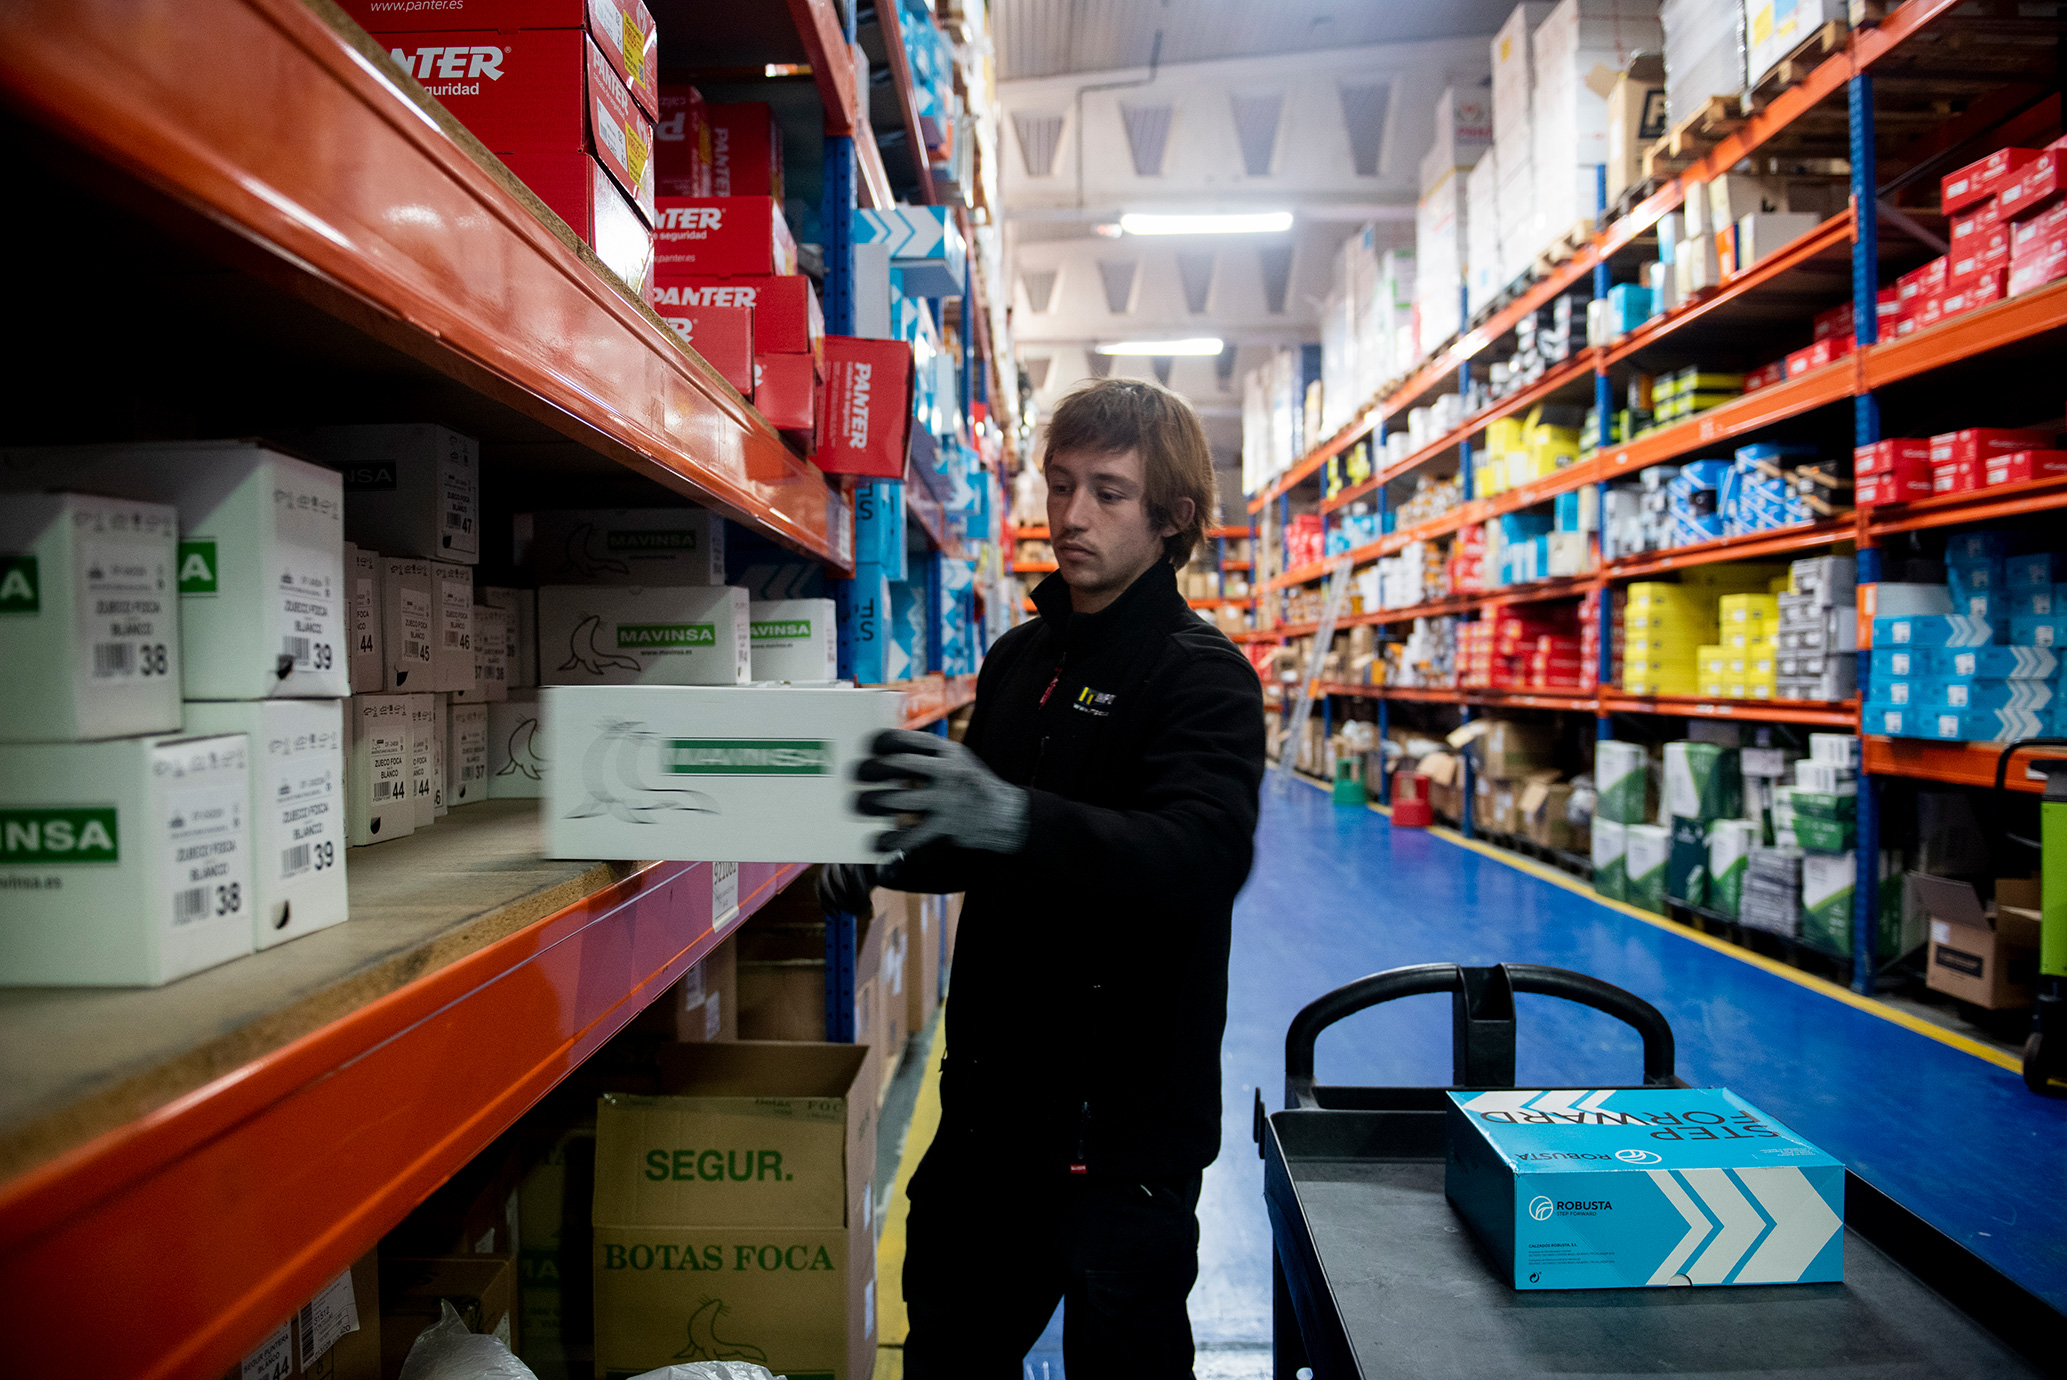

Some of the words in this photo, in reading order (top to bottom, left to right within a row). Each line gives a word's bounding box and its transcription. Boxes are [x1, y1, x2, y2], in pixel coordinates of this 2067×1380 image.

[371, 0, 464, 12] www.panter.es
[593, 50, 629, 116] PANTER
[659, 230, 707, 242] seguridad
[849, 362, 872, 449] PANTER
[462, 517, 473, 534] 47
[360, 634, 374, 653] 44
[459, 634, 470, 650] 46
[619, 628, 714, 643] MAVINSA
[141, 644, 169, 677] 38
[313, 642, 333, 670] 39
[419, 644, 430, 662] 45
[374, 759, 390, 768] ZUECO
[390, 757, 403, 766] FOCA
[475, 764, 485, 780] 37
[381, 769, 399, 779] BLANCO
[392, 781, 405, 800] 44
[418, 778, 430, 797] 44
[314, 840, 334, 871] 39
[215, 881, 242, 917] 38
[1480, 1109, 1761, 1125] FORWARD
[1650, 1125, 1780, 1142] STEP
[645, 1149, 793, 1182] SEGUR.
[1515, 1152, 1612, 1161] ROBUSTA
[1556, 1201, 1613, 1211] ROBUSTA
[603, 1244, 724, 1272] BOTAS
[733, 1244, 836, 1272] FOCA
[263, 1333, 289, 1357] PUNTERA
[257, 1351, 280, 1374] BLANCO
[272, 1355, 290, 1380] 44
